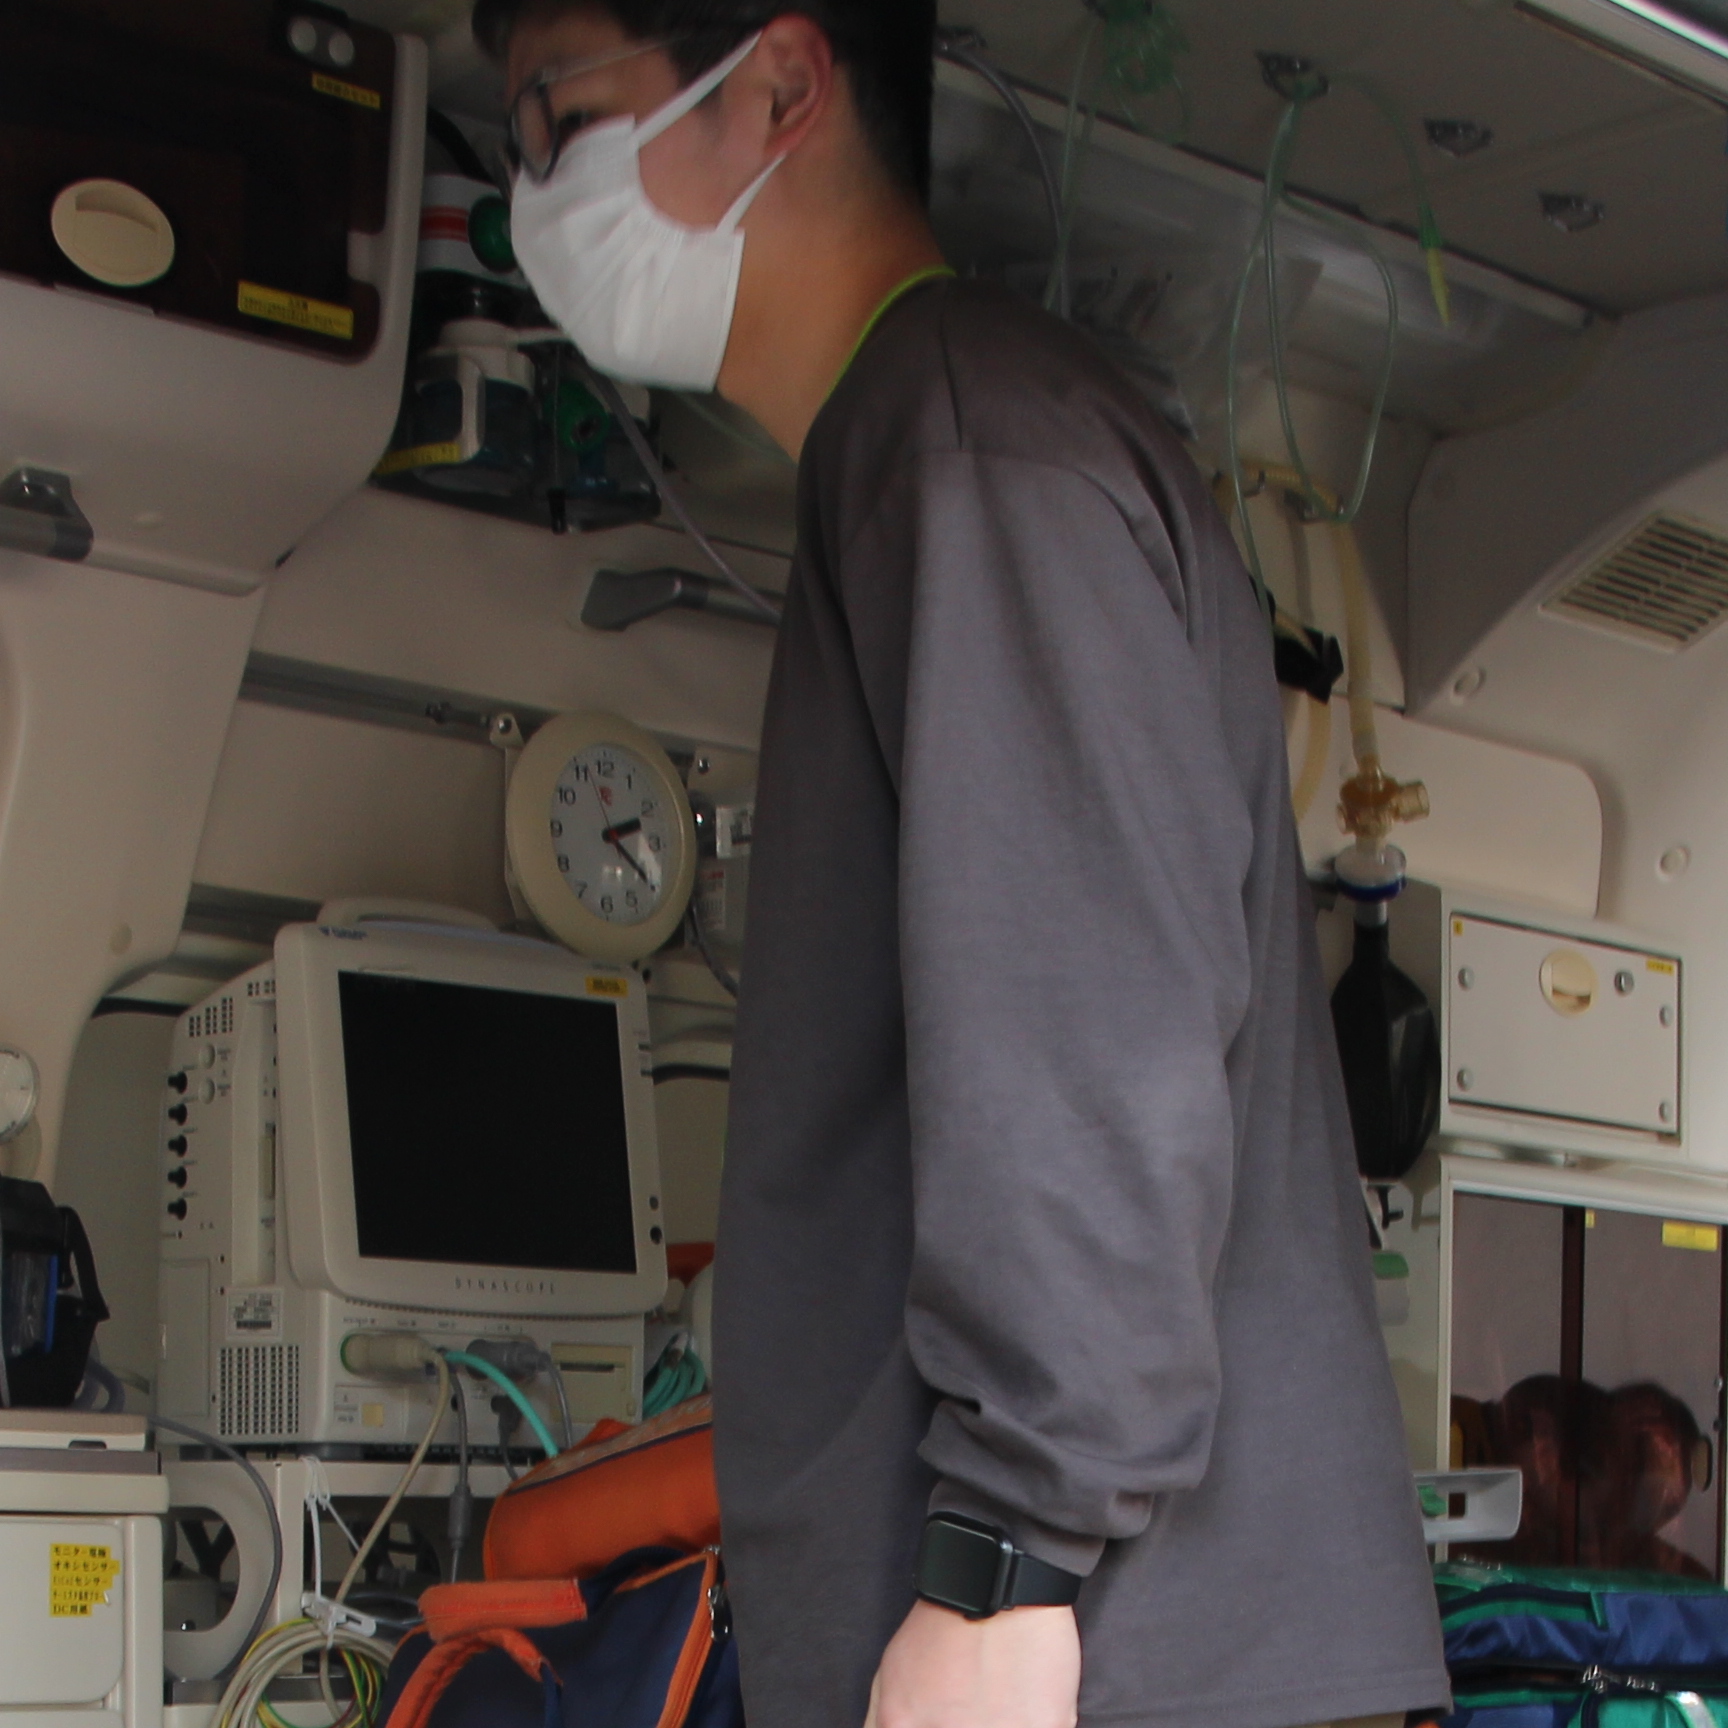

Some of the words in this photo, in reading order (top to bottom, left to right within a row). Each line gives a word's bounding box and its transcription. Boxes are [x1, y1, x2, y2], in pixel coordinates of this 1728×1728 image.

[574, 764, 589, 783] 11
[596, 758, 615, 778] 12
[626, 772, 633, 790] 1
[558, 786, 577, 806] 10
[549, 819, 564, 838] 9
[648, 833, 662, 852] 3
[557, 854, 571, 873] 8
[576, 880, 589, 899] 7
[600, 894, 615, 914] 6
